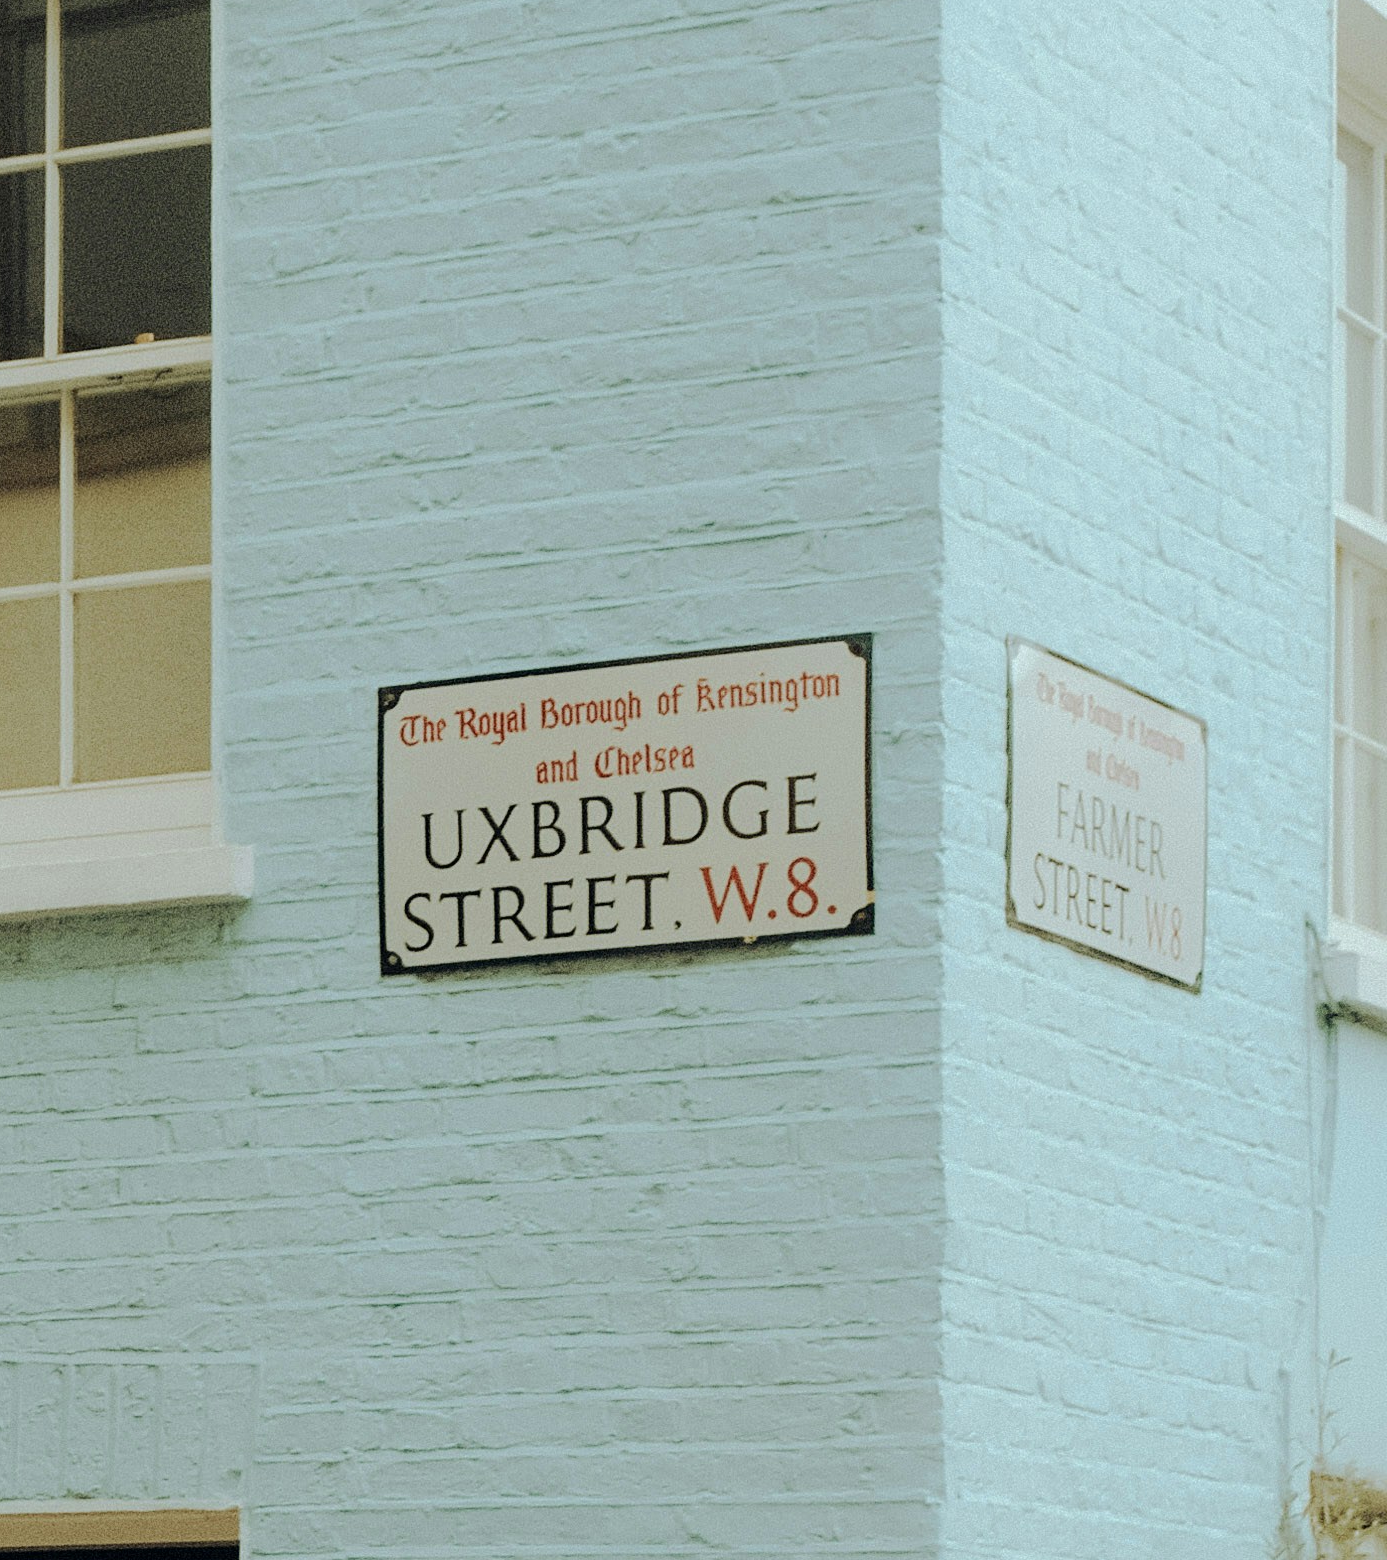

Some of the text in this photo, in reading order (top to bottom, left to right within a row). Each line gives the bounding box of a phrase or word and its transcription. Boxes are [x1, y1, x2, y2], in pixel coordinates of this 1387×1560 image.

[400, 672, 840, 746] The Royal Borough of Kensington
[536, 745, 695, 784] and Chelsea
[422, 773, 821, 870] UXBRIDGE
[1056, 782, 1166, 880] FARMER
[699, 857, 837, 924] W.8.
